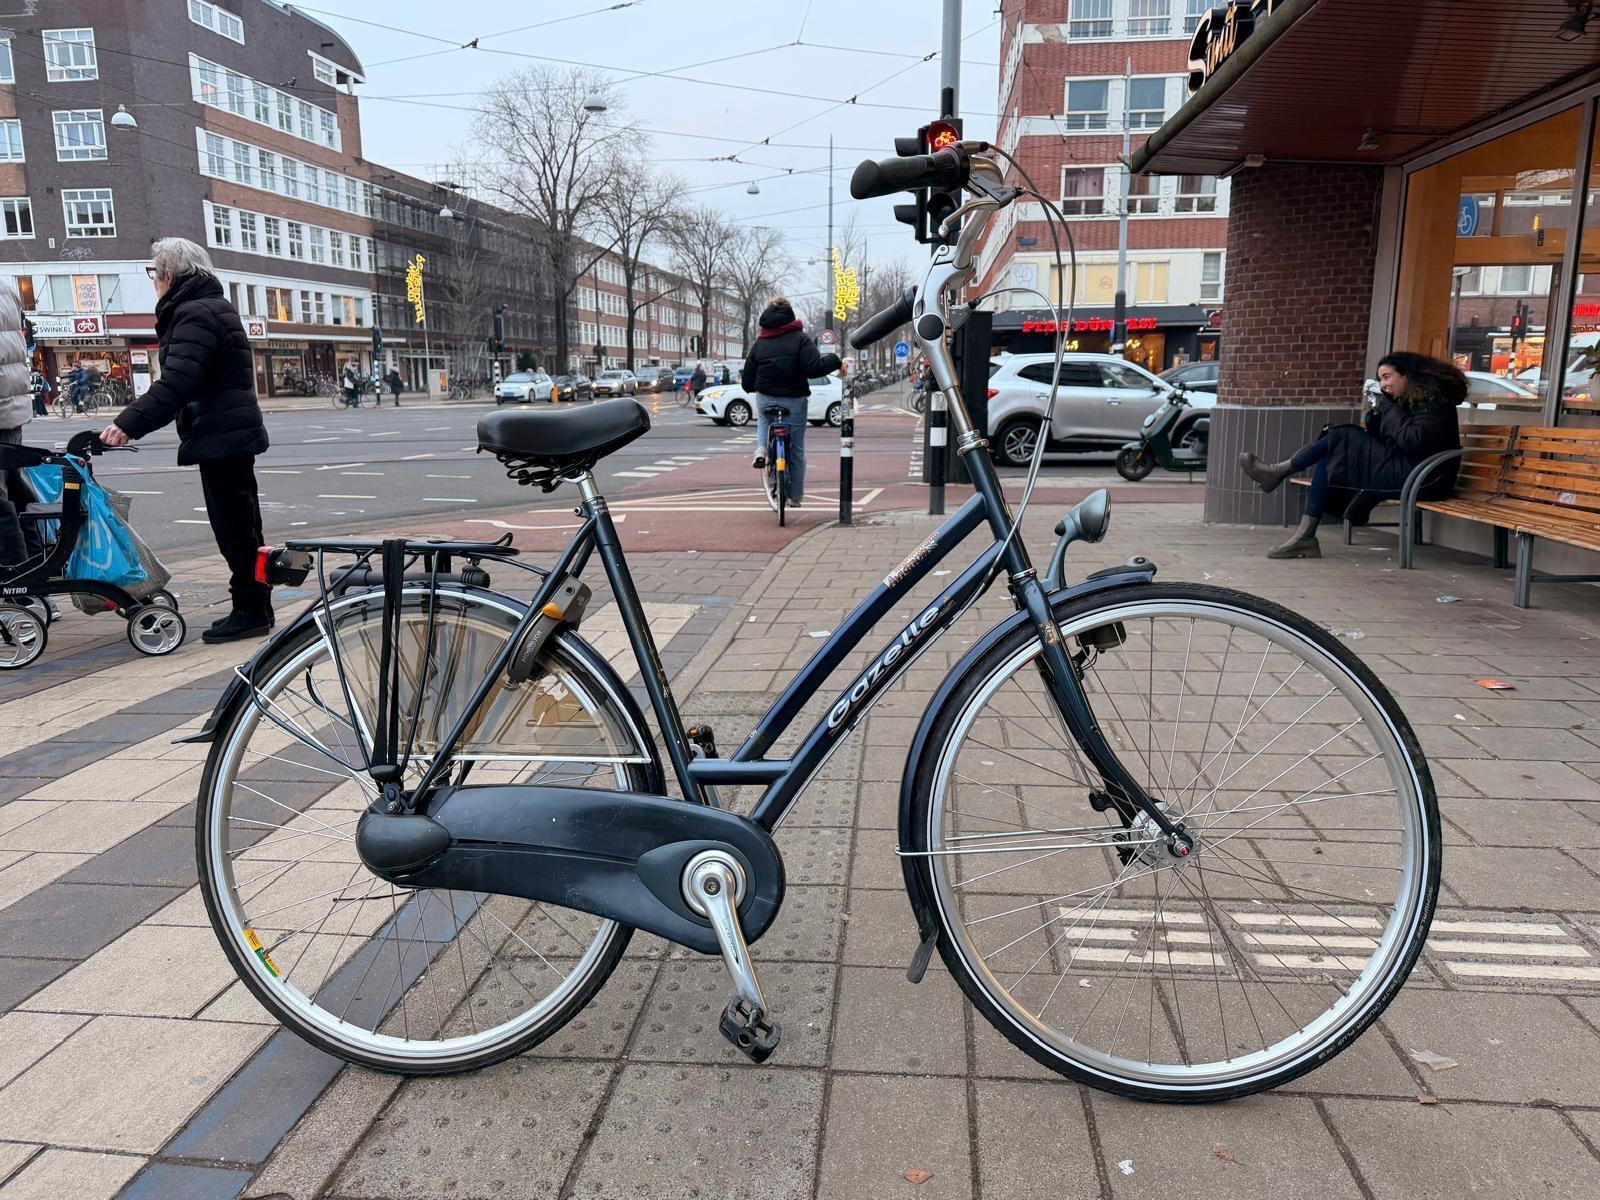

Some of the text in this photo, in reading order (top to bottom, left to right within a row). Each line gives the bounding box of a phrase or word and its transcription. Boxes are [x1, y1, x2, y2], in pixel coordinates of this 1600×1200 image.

[1188, 0, 1237, 97] Simit
[1074, 317, 1158, 332] DÜNASI
[58, 338, 113, 346] E-BIKES
[2, 586, 28, 595] NITRO
[827, 606, 940, 729] Gazelle
